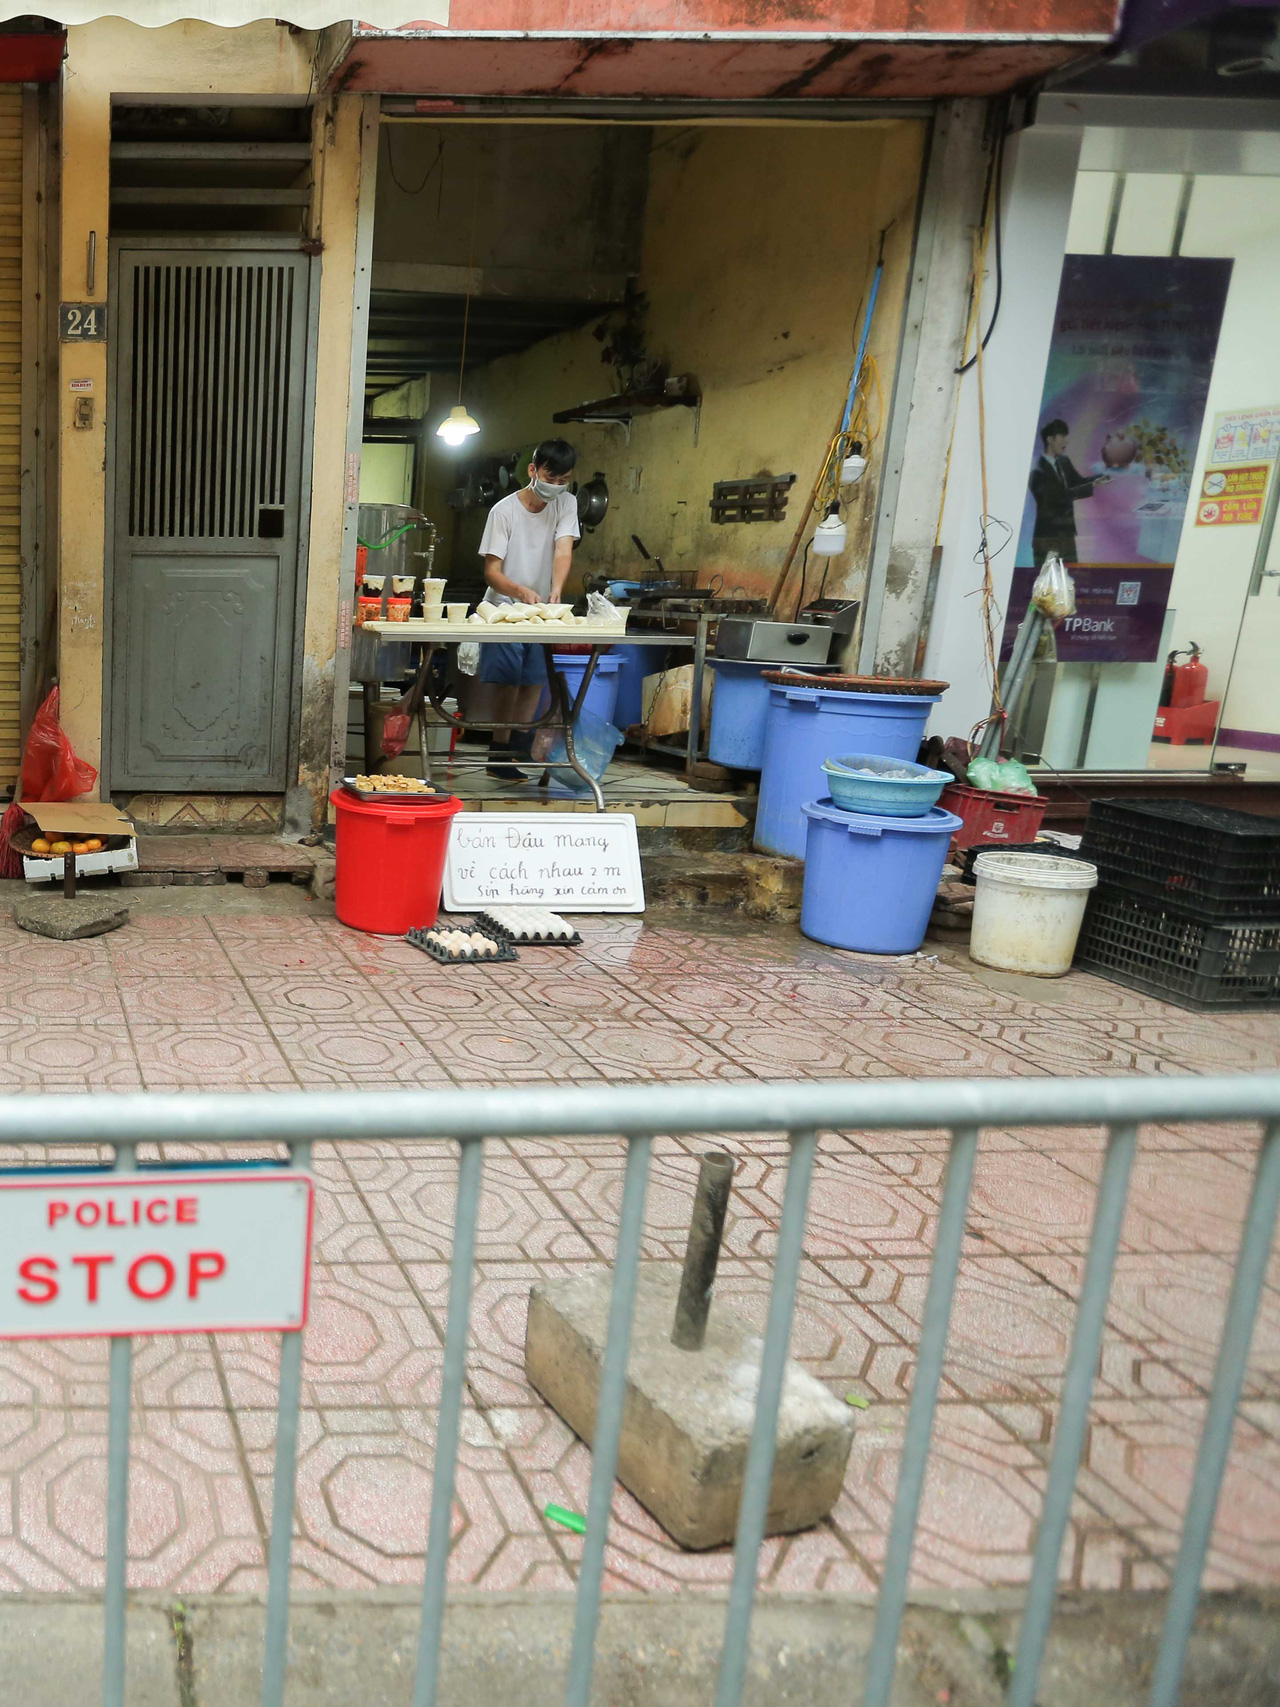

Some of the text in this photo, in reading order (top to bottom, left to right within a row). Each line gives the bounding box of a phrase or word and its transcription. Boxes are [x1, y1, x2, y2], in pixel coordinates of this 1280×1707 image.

[67, 309, 97, 335] 24
[1064, 617, 1115, 632] TPBank
[489, 861, 528, 880] cách
[538, 861, 583, 879] nhau
[590, 866, 597, 877] 2
[553, 885, 575, 897] xin
[580, 881, 608, 896] cảm
[47, 1197, 199, 1229] POLICE
[17, 1250, 227, 1305] STOP
